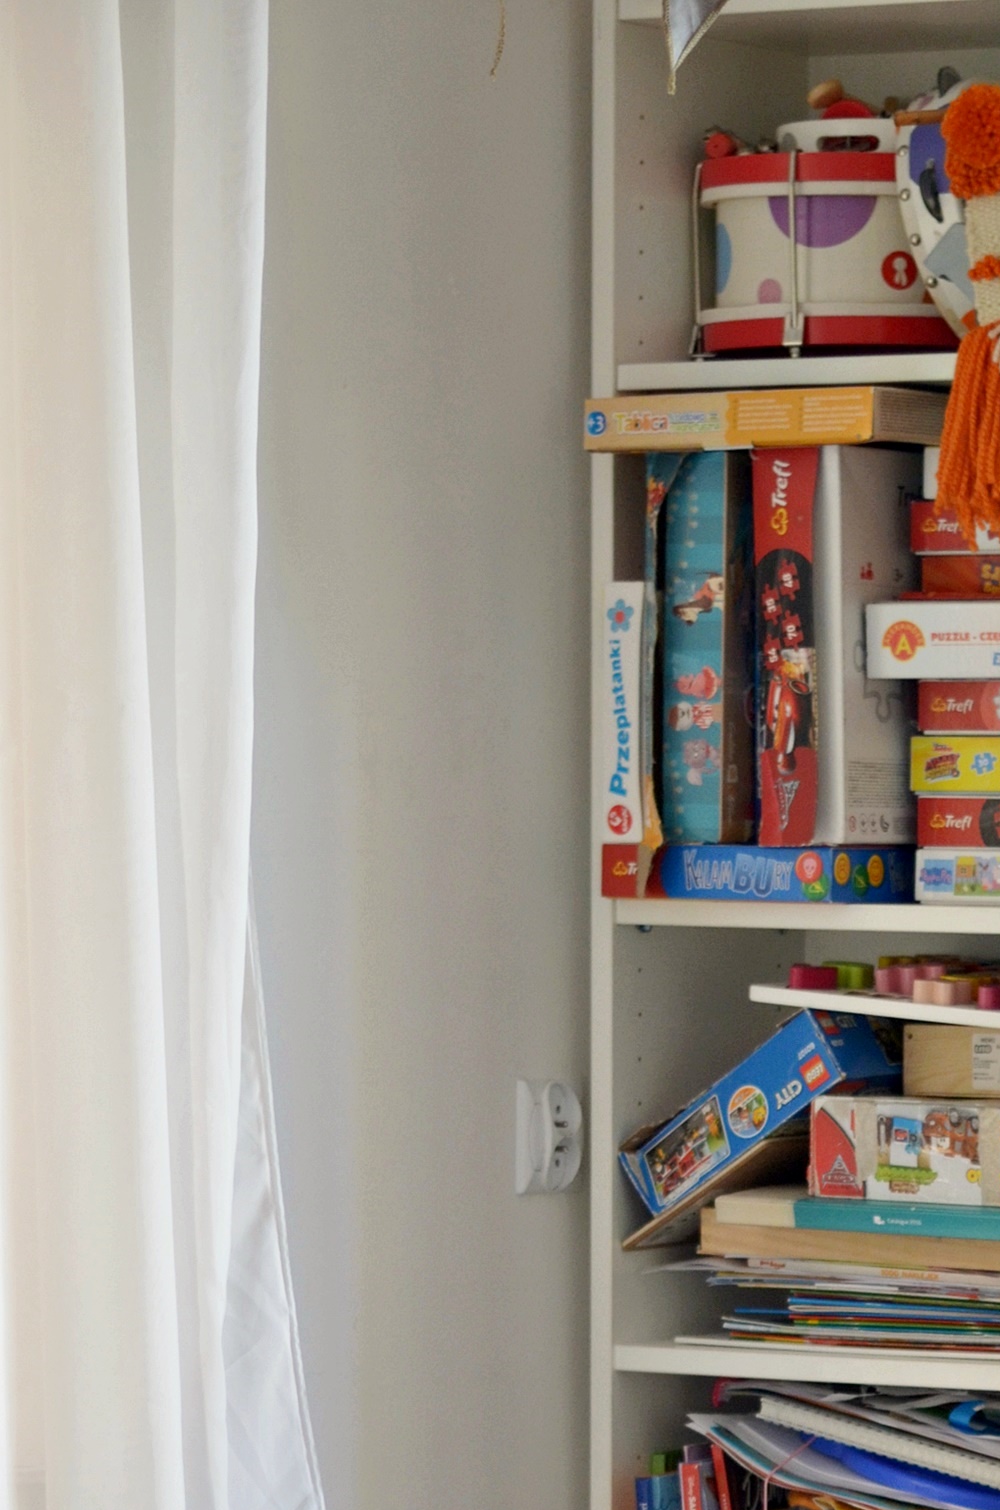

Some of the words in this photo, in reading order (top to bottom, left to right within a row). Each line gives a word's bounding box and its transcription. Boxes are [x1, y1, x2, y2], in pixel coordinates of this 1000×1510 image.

[614, 411, 669, 433] Tablica
[771, 460, 792, 508] Trefl
[937, 518, 960, 533] Tref
[894, 634, 913, 655] A
[930, 632, 971, 642] PUZZLE
[946, 699, 974, 714] Trefl
[607, 639, 632, 798] Przeplatanki
[945, 814, 972, 830] Trefl
[775, 1079, 803, 1111] CITY
